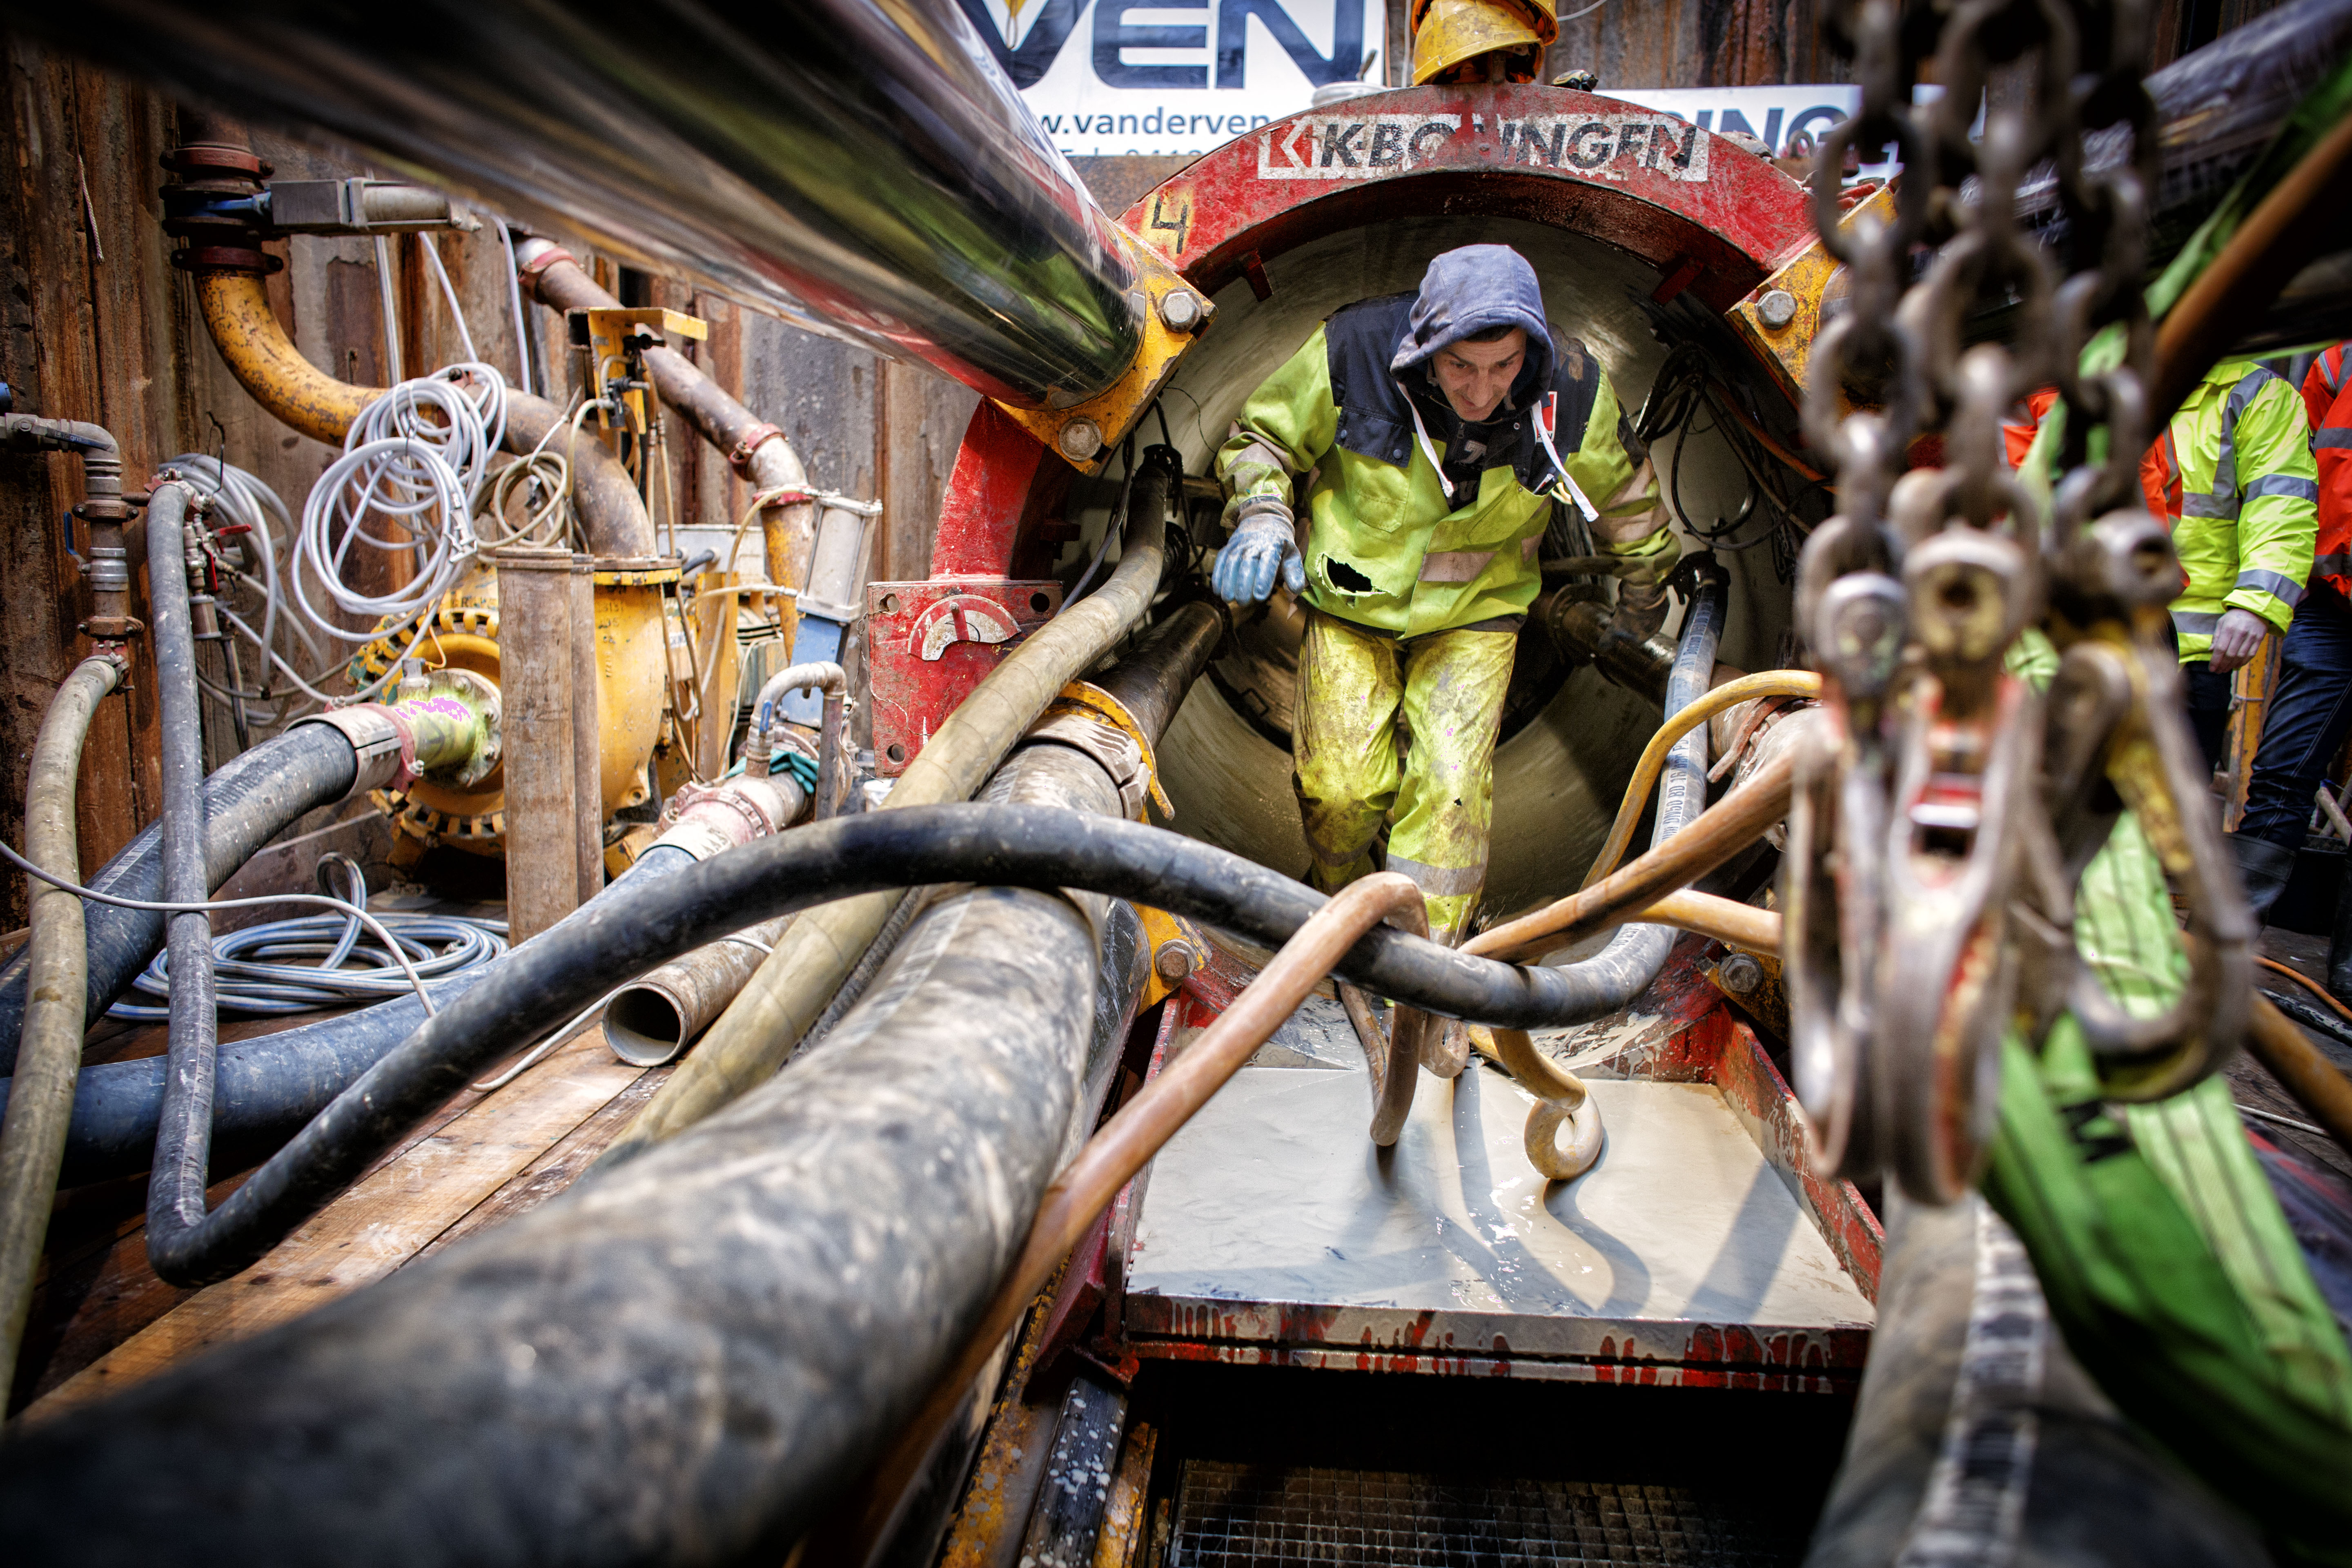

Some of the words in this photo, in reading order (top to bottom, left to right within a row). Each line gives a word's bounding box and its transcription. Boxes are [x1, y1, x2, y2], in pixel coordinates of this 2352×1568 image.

[1151, 196, 1188, 254] 4
[1670, 771, 1687, 783] 16
[1668, 785, 1685, 799] BD
[1662, 800, 1683, 825] DN50
